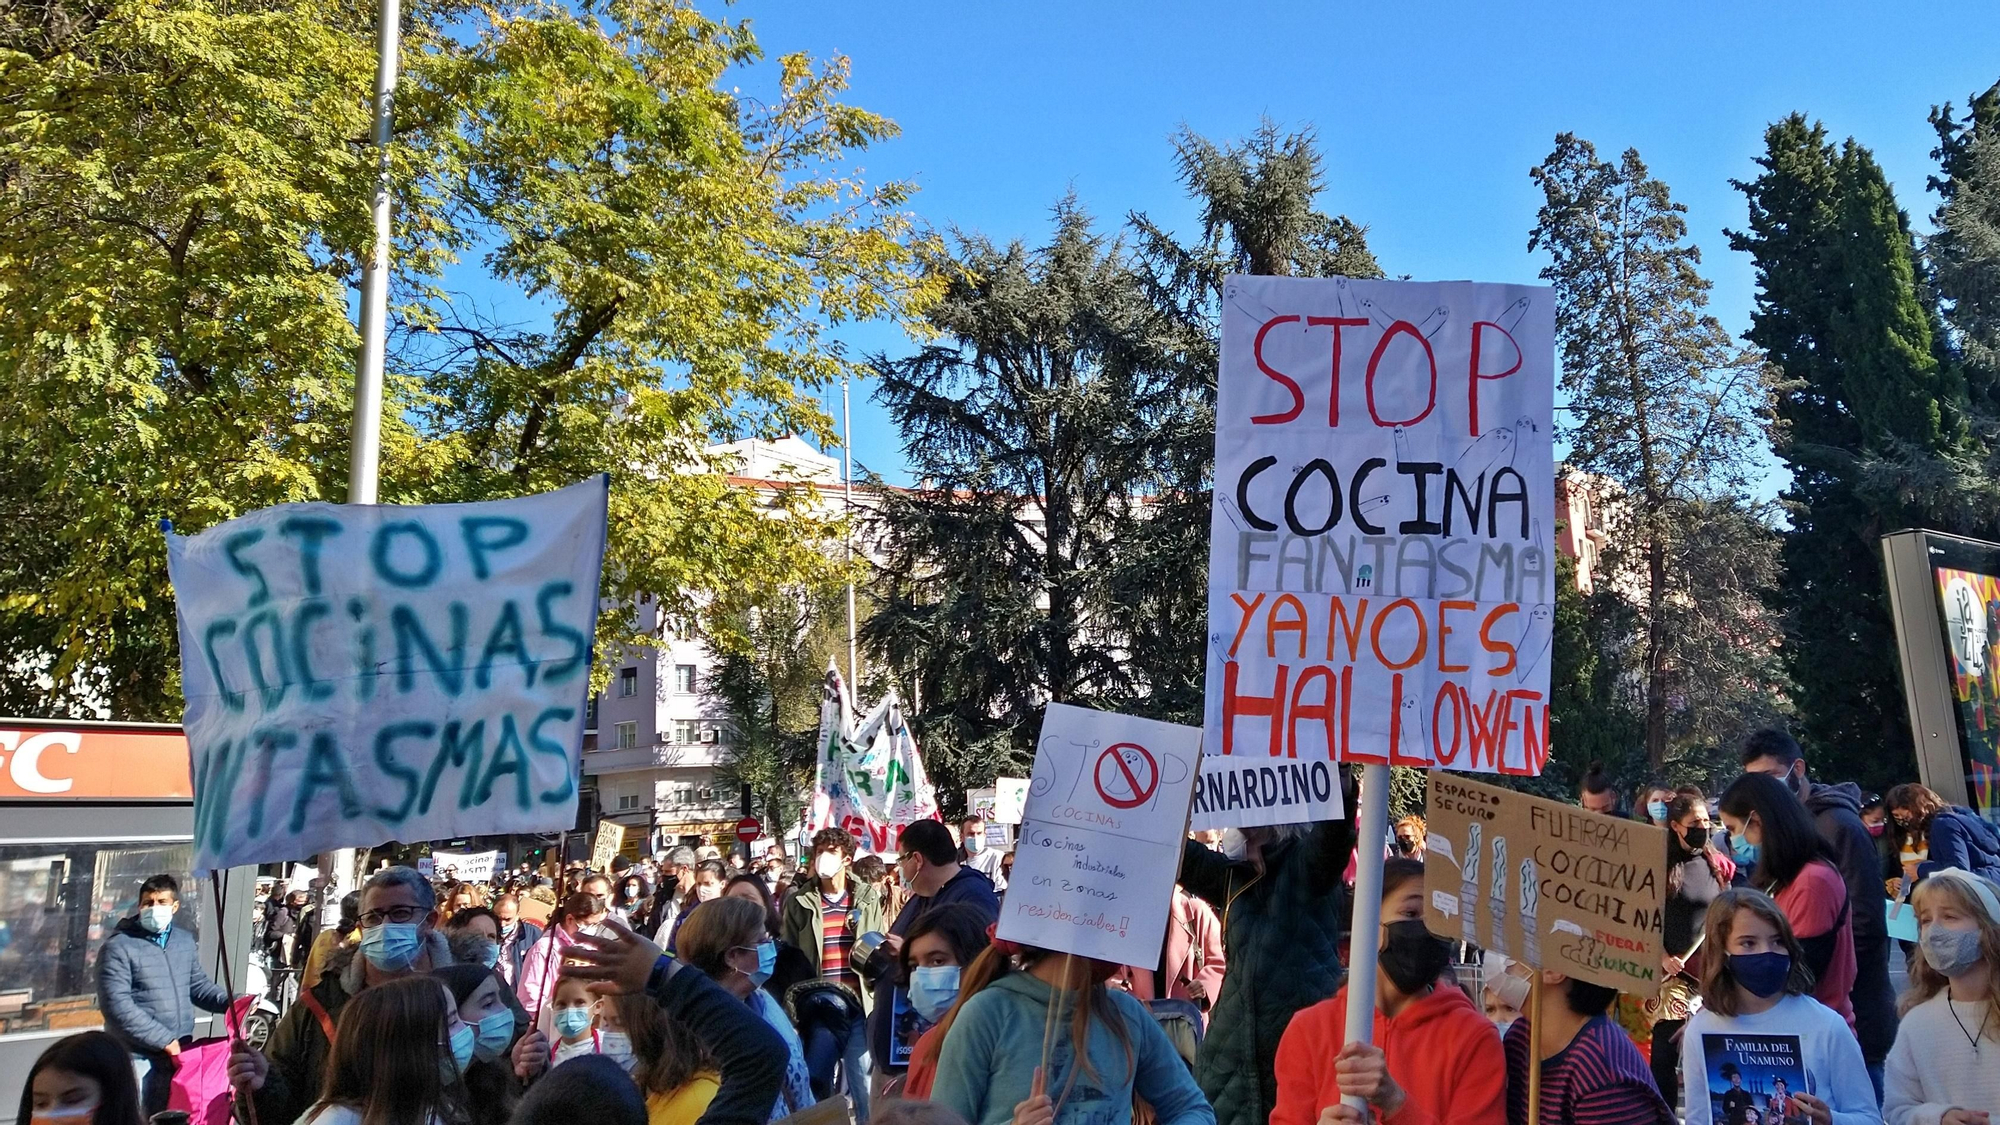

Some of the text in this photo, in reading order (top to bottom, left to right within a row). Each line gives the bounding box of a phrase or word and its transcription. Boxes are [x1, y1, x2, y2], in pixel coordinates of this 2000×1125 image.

[1250, 314, 1524, 438] STOP
[1237, 454, 1530, 540] COCINA
[223, 515, 531, 608] STOP
[1237, 530, 1547, 602] FANTASMA
[1051, 804, 1123, 831] COCINAS
[1031, 875, 1119, 901] en zonas
[1739, 1052, 1795, 1067] UNAMUNO
[1770, 1043, 1794, 1053] DEL
